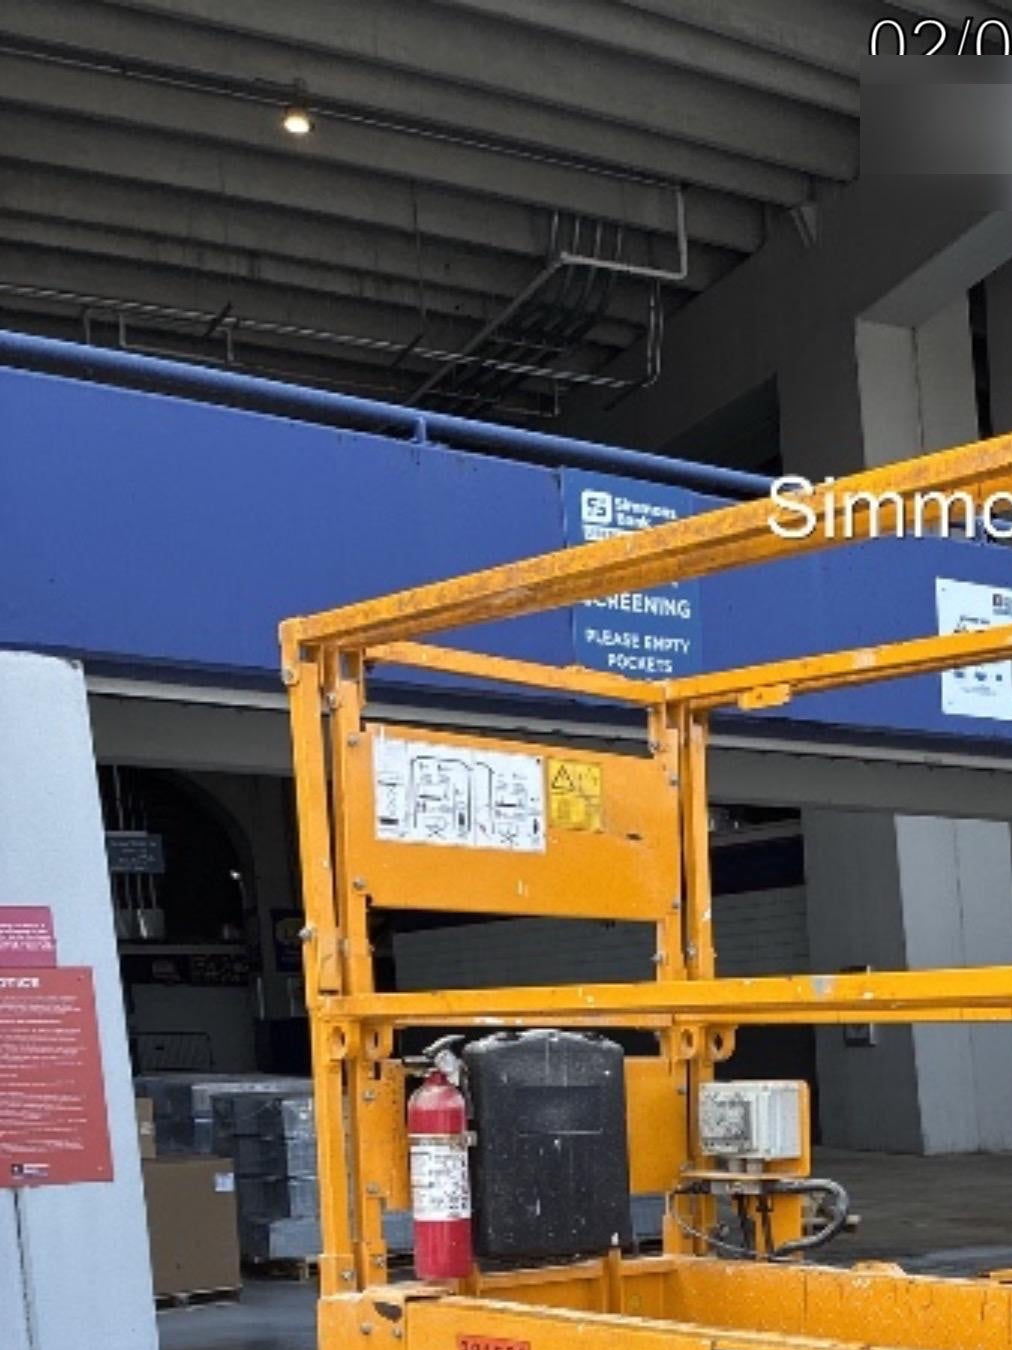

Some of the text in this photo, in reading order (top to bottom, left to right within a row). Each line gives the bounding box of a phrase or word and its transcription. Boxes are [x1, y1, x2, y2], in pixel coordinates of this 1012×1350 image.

[585, 629, 690, 654] PLEASE EMPTY
[608, 653, 673, 673] POCKETS
